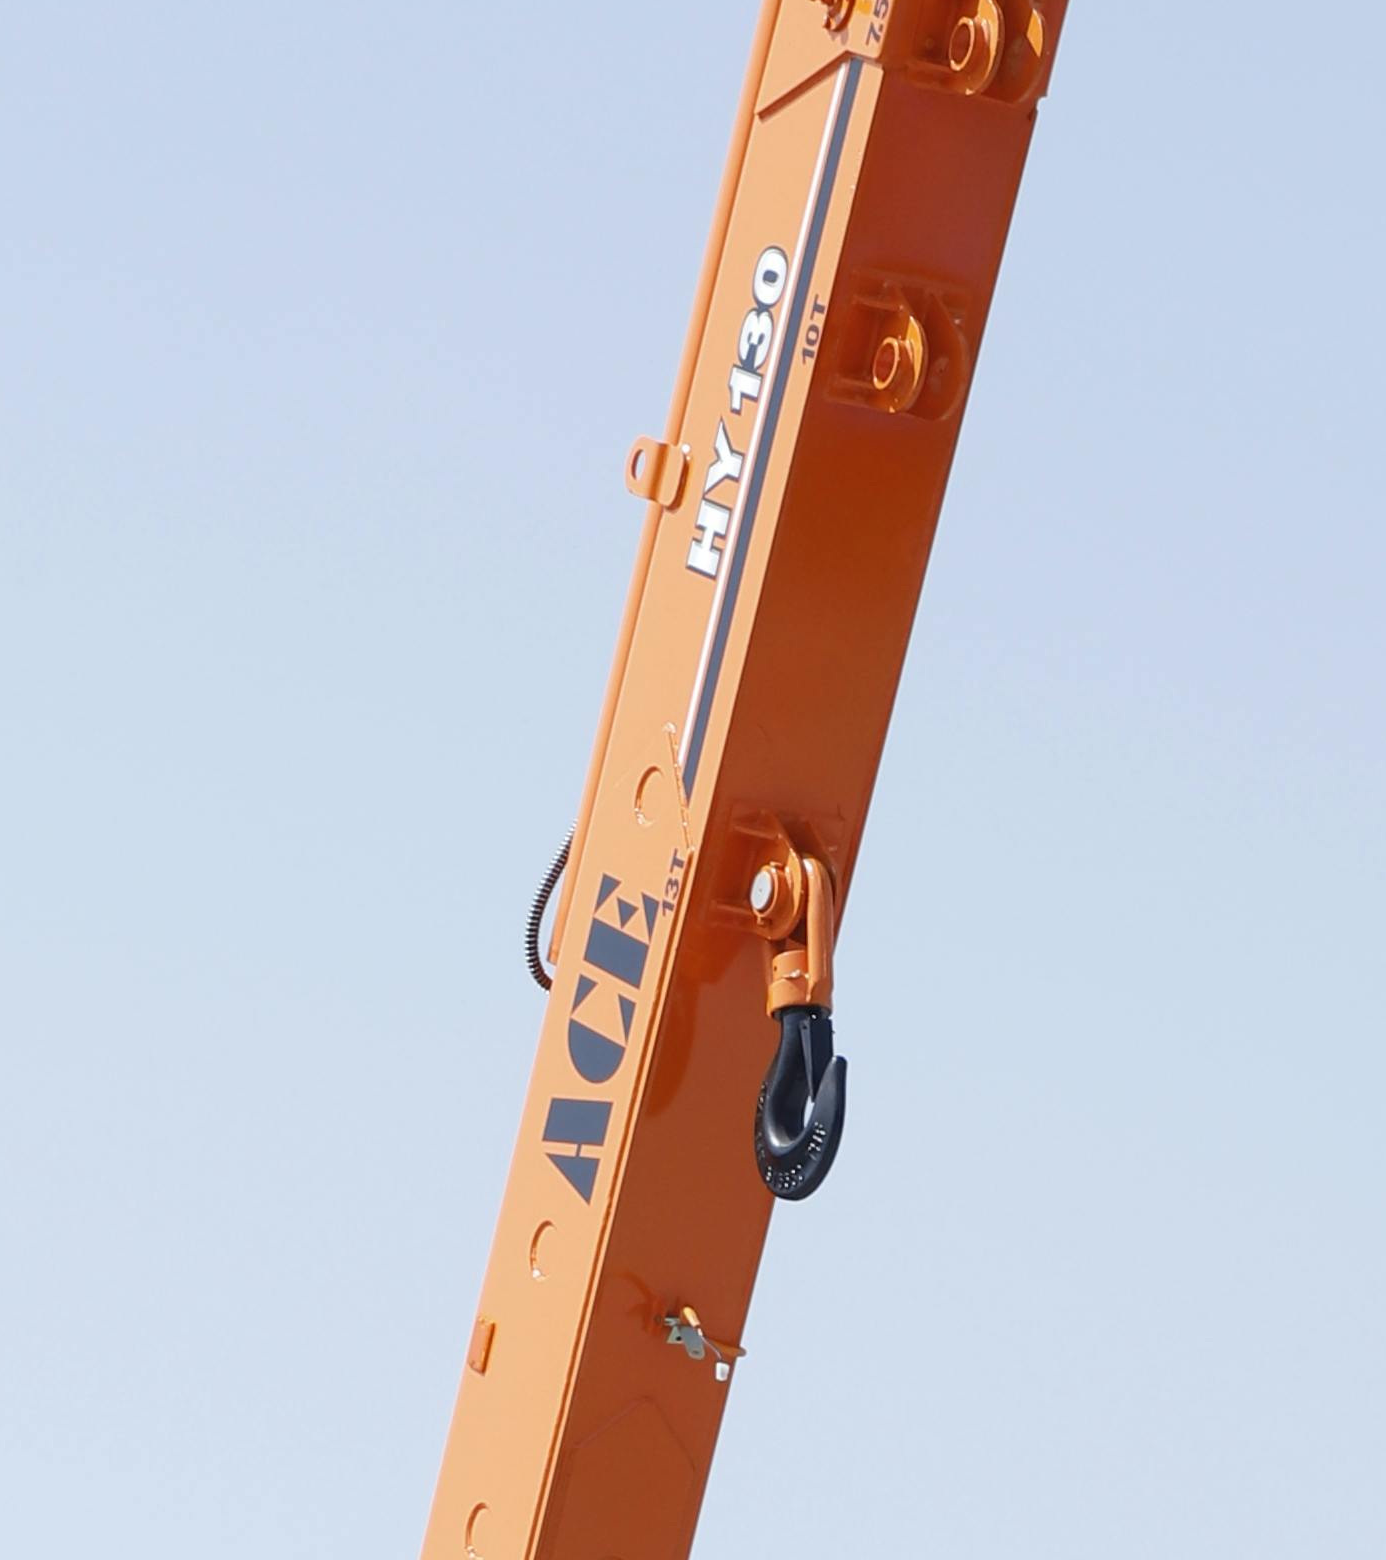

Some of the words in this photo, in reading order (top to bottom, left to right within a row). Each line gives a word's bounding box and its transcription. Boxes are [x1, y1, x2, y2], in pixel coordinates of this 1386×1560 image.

[685, 414, 746, 582] HY
[728, 245, 790, 416] 130
[541, 871, 661, 1207] ACE
[662, 847, 687, 918] 13T
